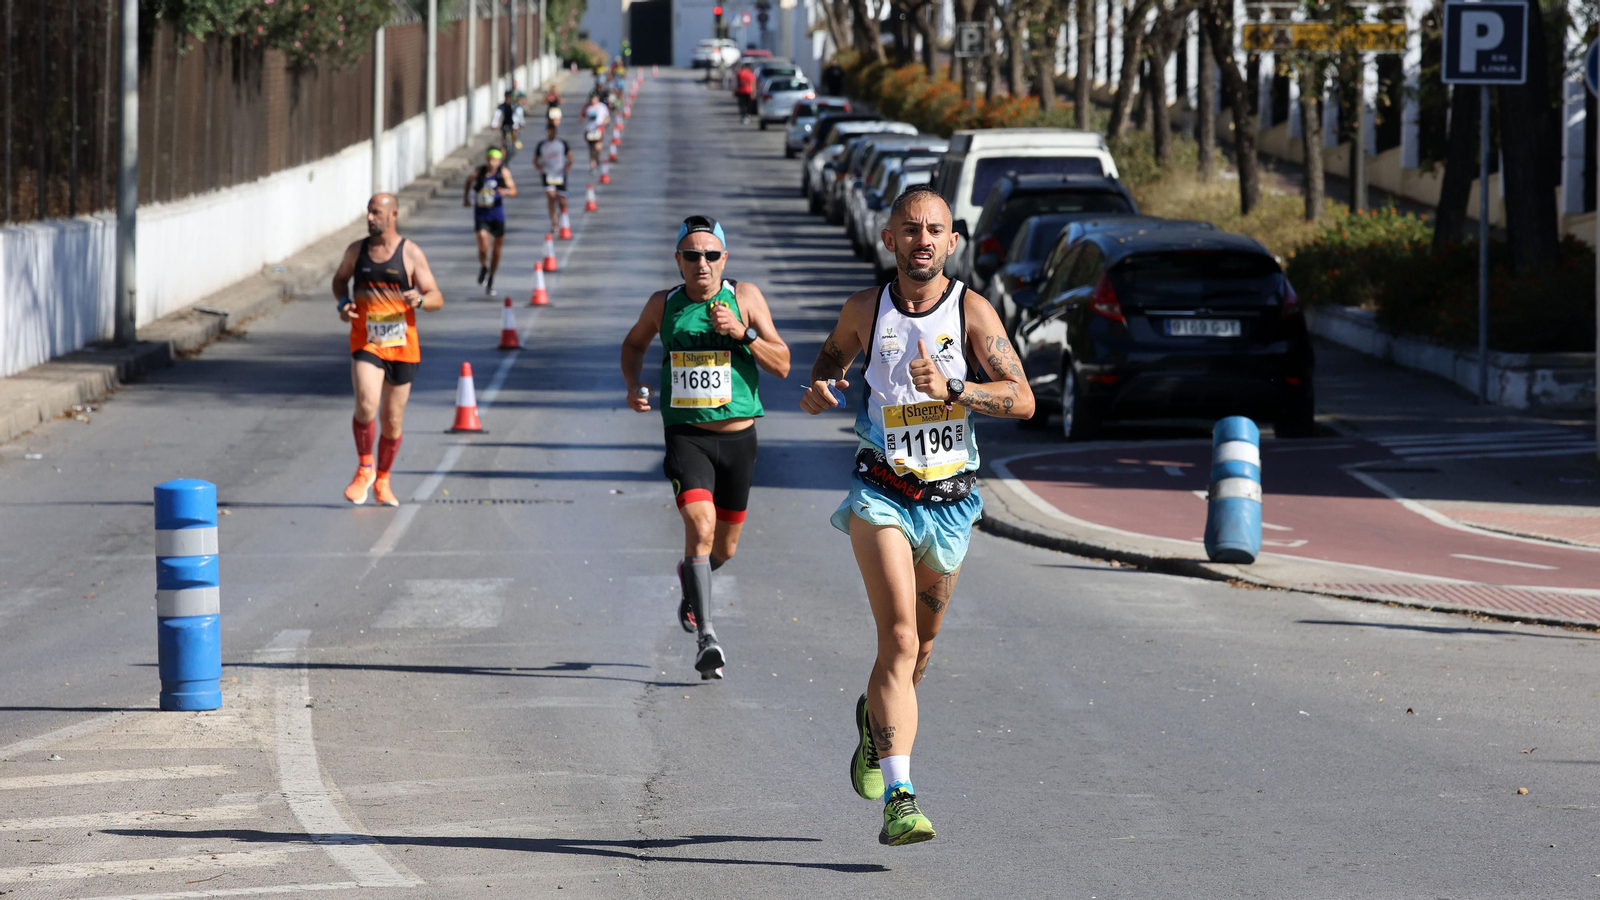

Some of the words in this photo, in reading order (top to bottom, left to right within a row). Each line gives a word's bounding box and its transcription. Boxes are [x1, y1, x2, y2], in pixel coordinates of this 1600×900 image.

[961, 28, 981, 51] P
[1459, 10, 1505, 73] P
[680, 370, 721, 390] 1683
[906, 402, 946, 419] Sherry
[921, 414, 941, 423] Media
[901, 425, 954, 457] 1196
